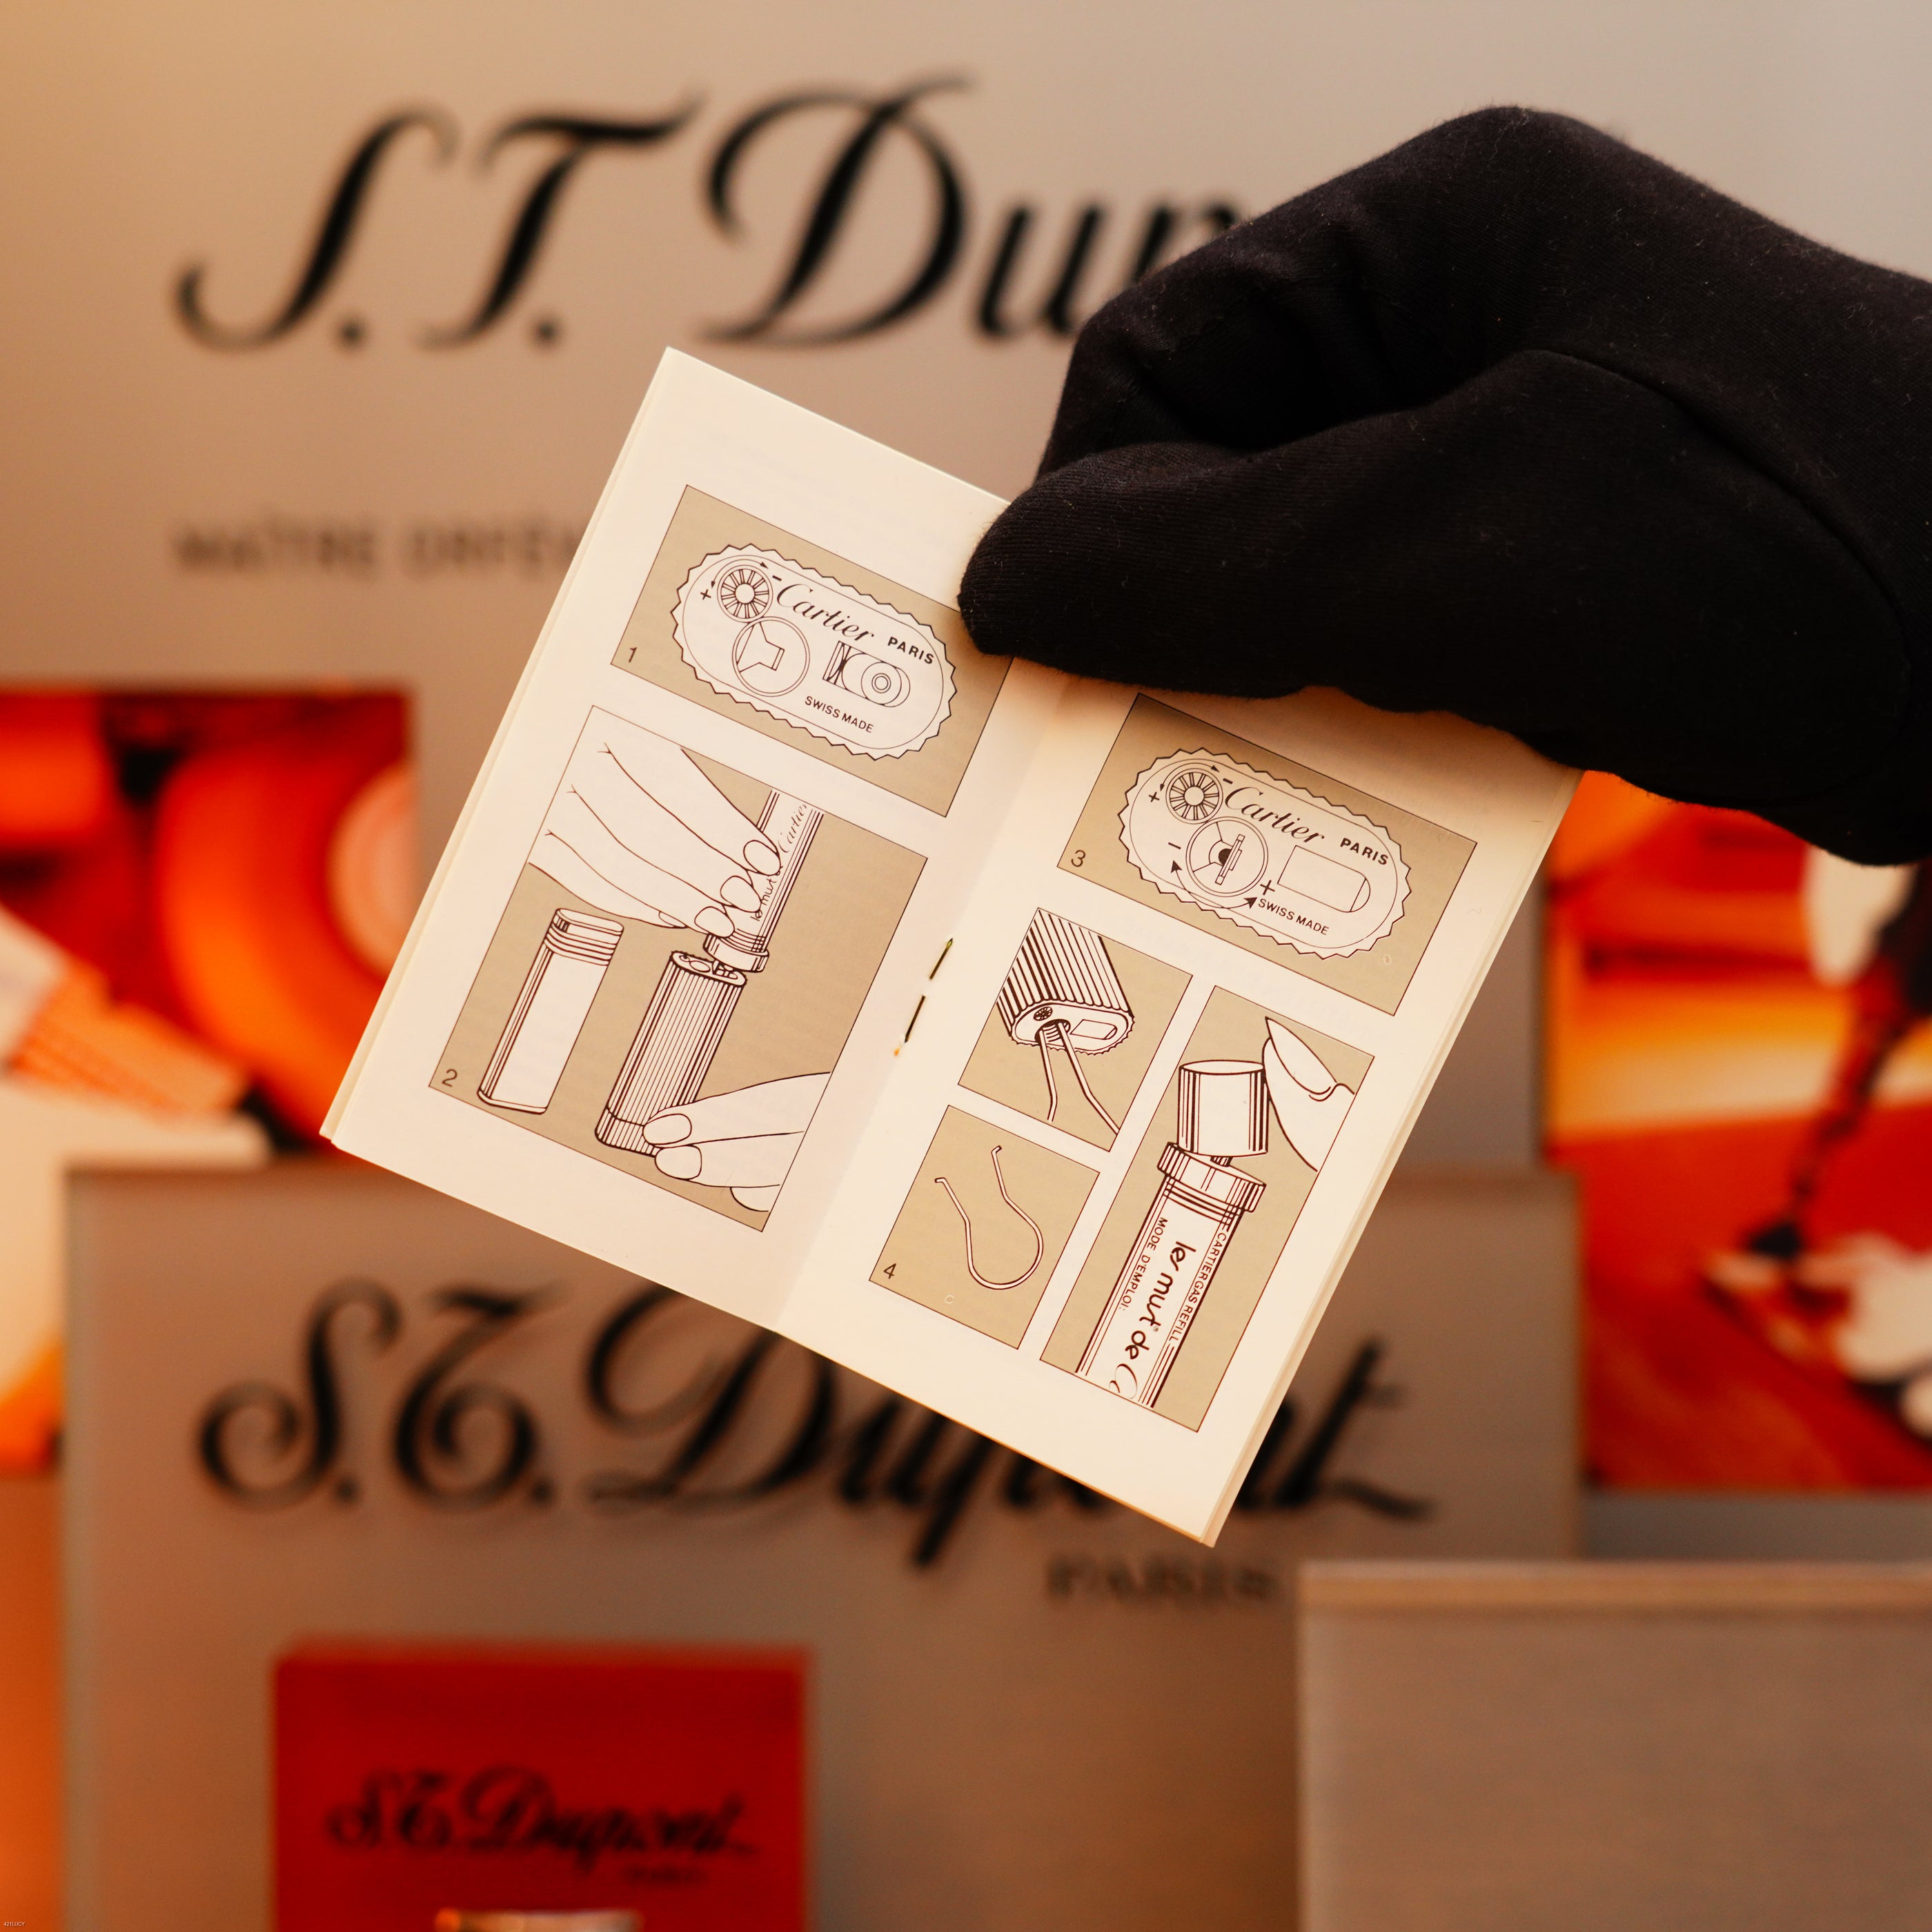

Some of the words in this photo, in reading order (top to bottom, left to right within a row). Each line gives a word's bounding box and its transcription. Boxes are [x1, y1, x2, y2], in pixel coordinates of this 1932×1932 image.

[776, 583, 874, 641] Cartier
[887, 636, 934, 664] PARIS
[629, 647, 637, 662] 1
[805, 696, 840, 718] SWISS
[841, 713, 874, 733] MADE
[1225, 787, 1325, 843] Cartier
[1340, 838, 1389, 865] PARIS
[1071, 849, 1086, 867] 3
[1258, 898, 1294, 920] SWISS
[1296, 915, 1330, 936] MADE
[442, 1069, 457, 1087] 2
[1147, 1217, 1168, 1251] MODE
[883, 1263, 897, 1279] 4
[1169, 1305, 1193, 1341] REFILL
[1125, 1330, 1150, 1360] de
